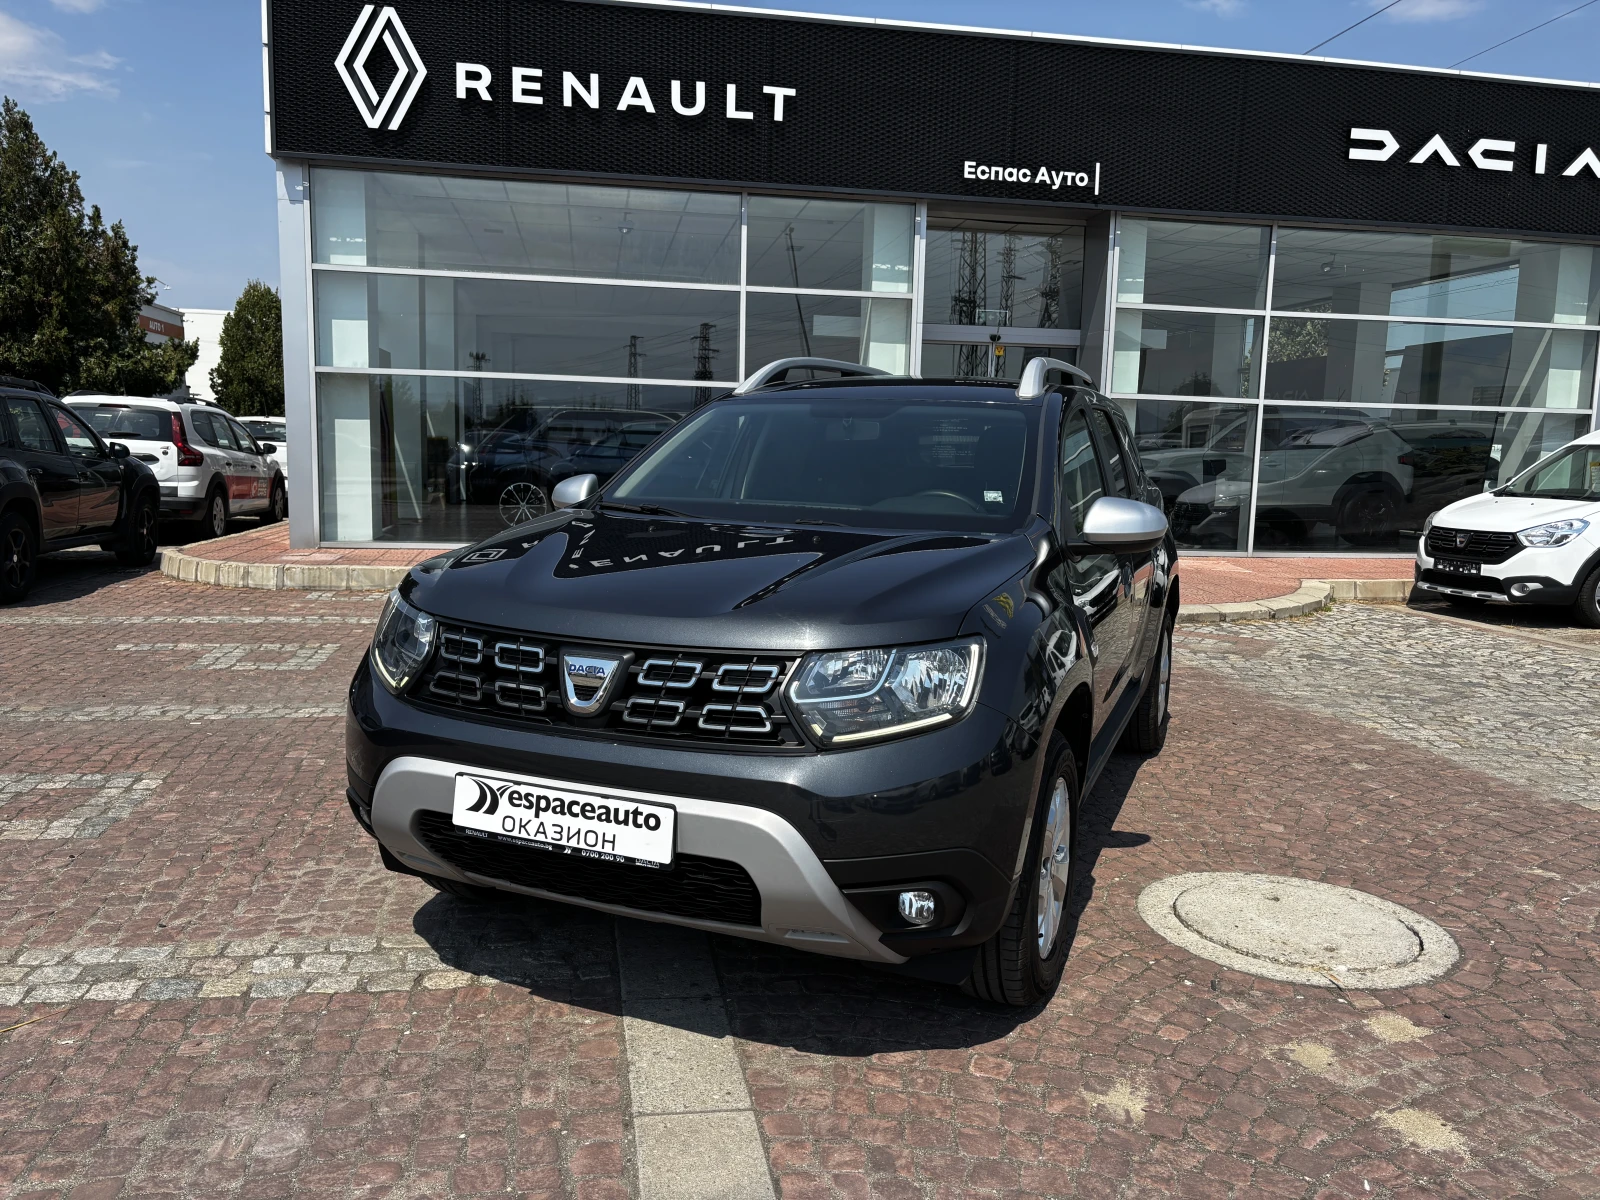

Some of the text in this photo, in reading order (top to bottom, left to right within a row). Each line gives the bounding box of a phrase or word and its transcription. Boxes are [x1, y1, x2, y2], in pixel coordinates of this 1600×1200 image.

[456, 62, 796, 122] RENAULT
[1348, 127, 1600, 179] DACIA
[963, 160, 1089, 190] Еспас Ауто
[149, 320, 161, 331] AUTO
[569, 663, 606, 676] DACIA
[507, 789, 661, 831] espaceauto
[465, 828, 489, 838] RENAULT
[501, 815, 617, 851] ОКАЗИОН
[581, 849, 625, 863] 0700 200 90
